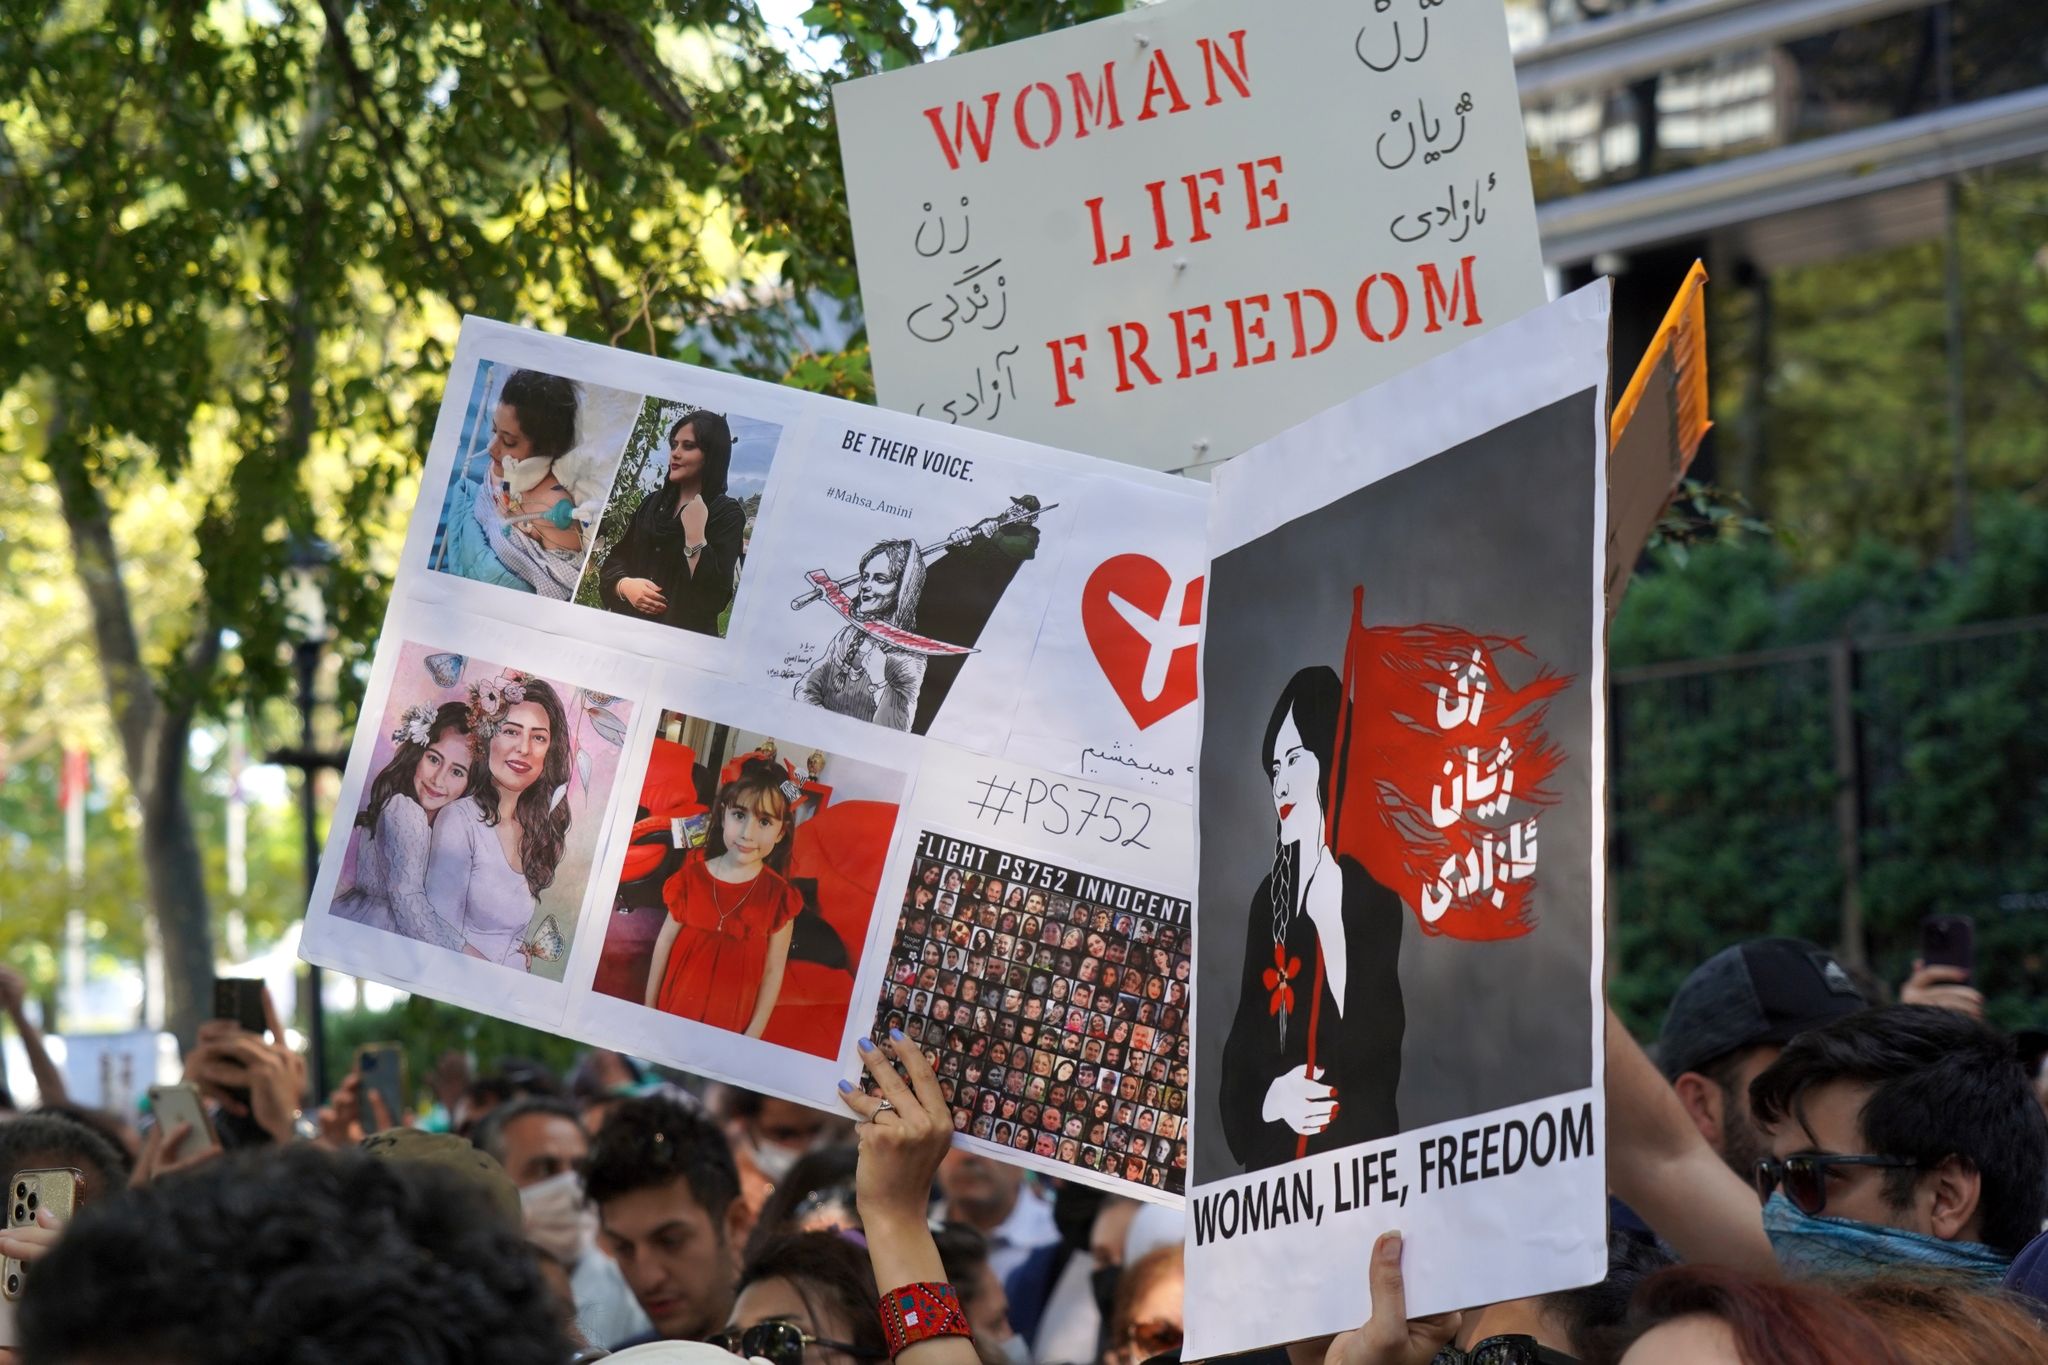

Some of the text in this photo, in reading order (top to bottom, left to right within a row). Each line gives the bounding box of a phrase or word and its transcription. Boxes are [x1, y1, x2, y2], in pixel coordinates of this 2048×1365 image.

[924, 30, 1251, 170] WOMAN
[915, 196, 969, 257] زن
[1085, 155, 1289, 266] LIFE
[907, 258, 1006, 342] زندگی
[1045, 255, 1483, 407] FREEDOM
[841, 430, 974, 482] BE THEIR VOICE.
[826, 487, 913, 519] #Mahsa_Amini
[1437, 649, 1486, 729] ژن
[968, 775, 1151, 850] #PS752
[997, 854, 1068, 892] PS752
[1076, 876, 1189, 924] INNOCENT
[1193, 1102, 1595, 1247] WOMAN, LIFE, FREEDOM
